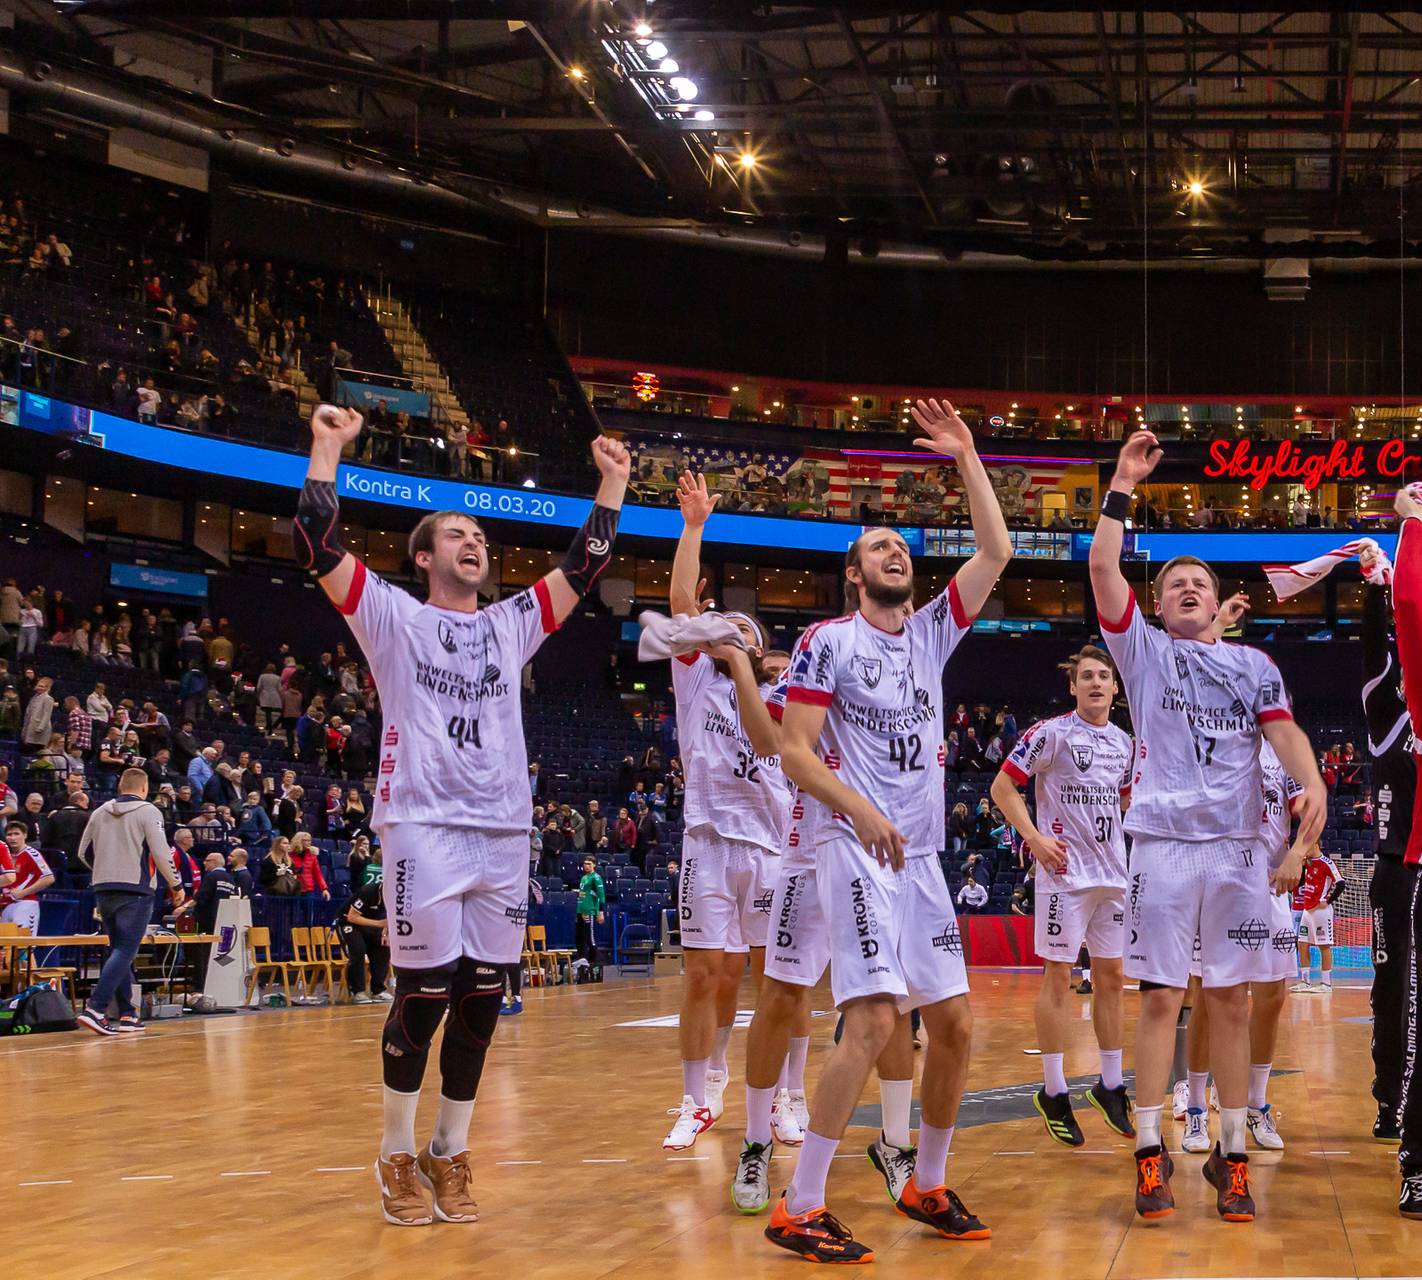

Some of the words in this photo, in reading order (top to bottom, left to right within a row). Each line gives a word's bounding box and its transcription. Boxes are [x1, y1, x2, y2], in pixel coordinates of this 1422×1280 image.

[1203, 439, 1366, 490] Skylight
[345, 472, 412, 500] Kontra
[417, 484, 431, 502] K
[463, 490, 556, 518] 08.03.20
[734, 751, 760, 783] 32
[889, 733, 925, 772] 42
[1194, 734, 1216, 766] 17
[1095, 816, 1112, 843] 37
[1241, 849, 1254, 867] 17
[396, 858, 407, 916] KRONA
[405, 858, 416, 917] COATINGS
[682, 858, 693, 904] KRONA
[780, 875, 799, 928] KRONA
[789, 875, 807, 930] COATINGS
[863, 876, 879, 936] COATINGS
[1048, 893, 1058, 920] KRO
